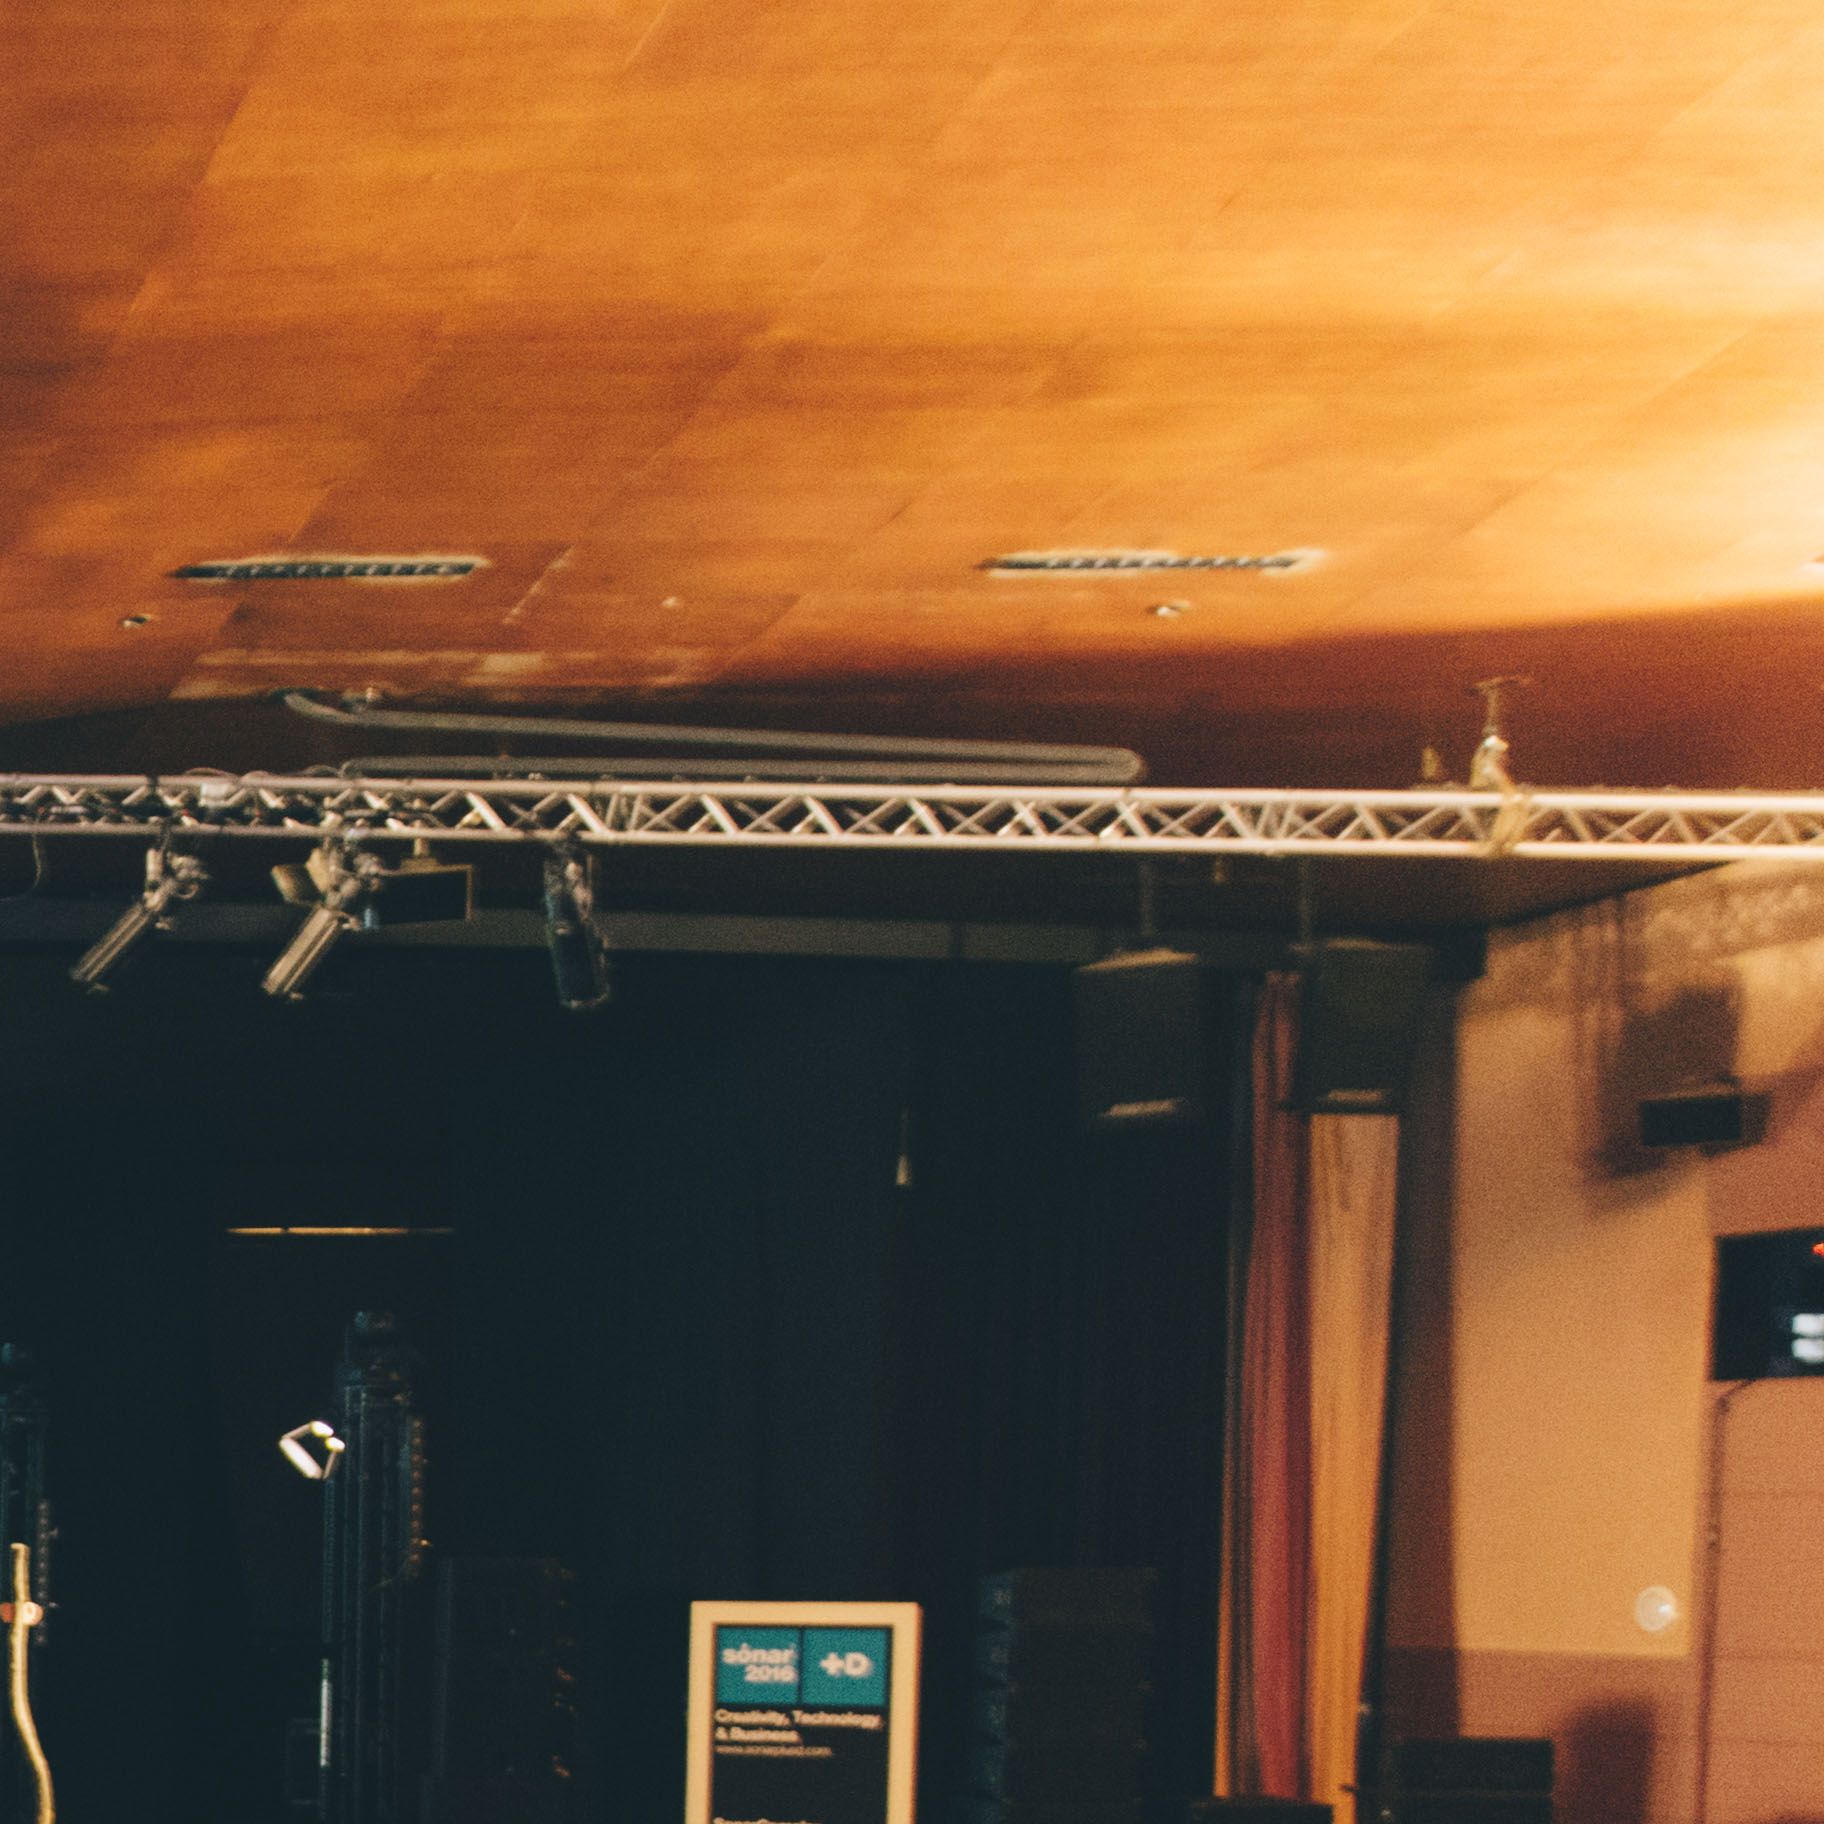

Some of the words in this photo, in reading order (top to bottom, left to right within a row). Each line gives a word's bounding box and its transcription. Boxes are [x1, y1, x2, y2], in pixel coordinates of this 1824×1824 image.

[743, 1665, 797, 1683] 2016
[792, 1709, 883, 1730] Technology
[730, 1726, 801, 1743] Business
